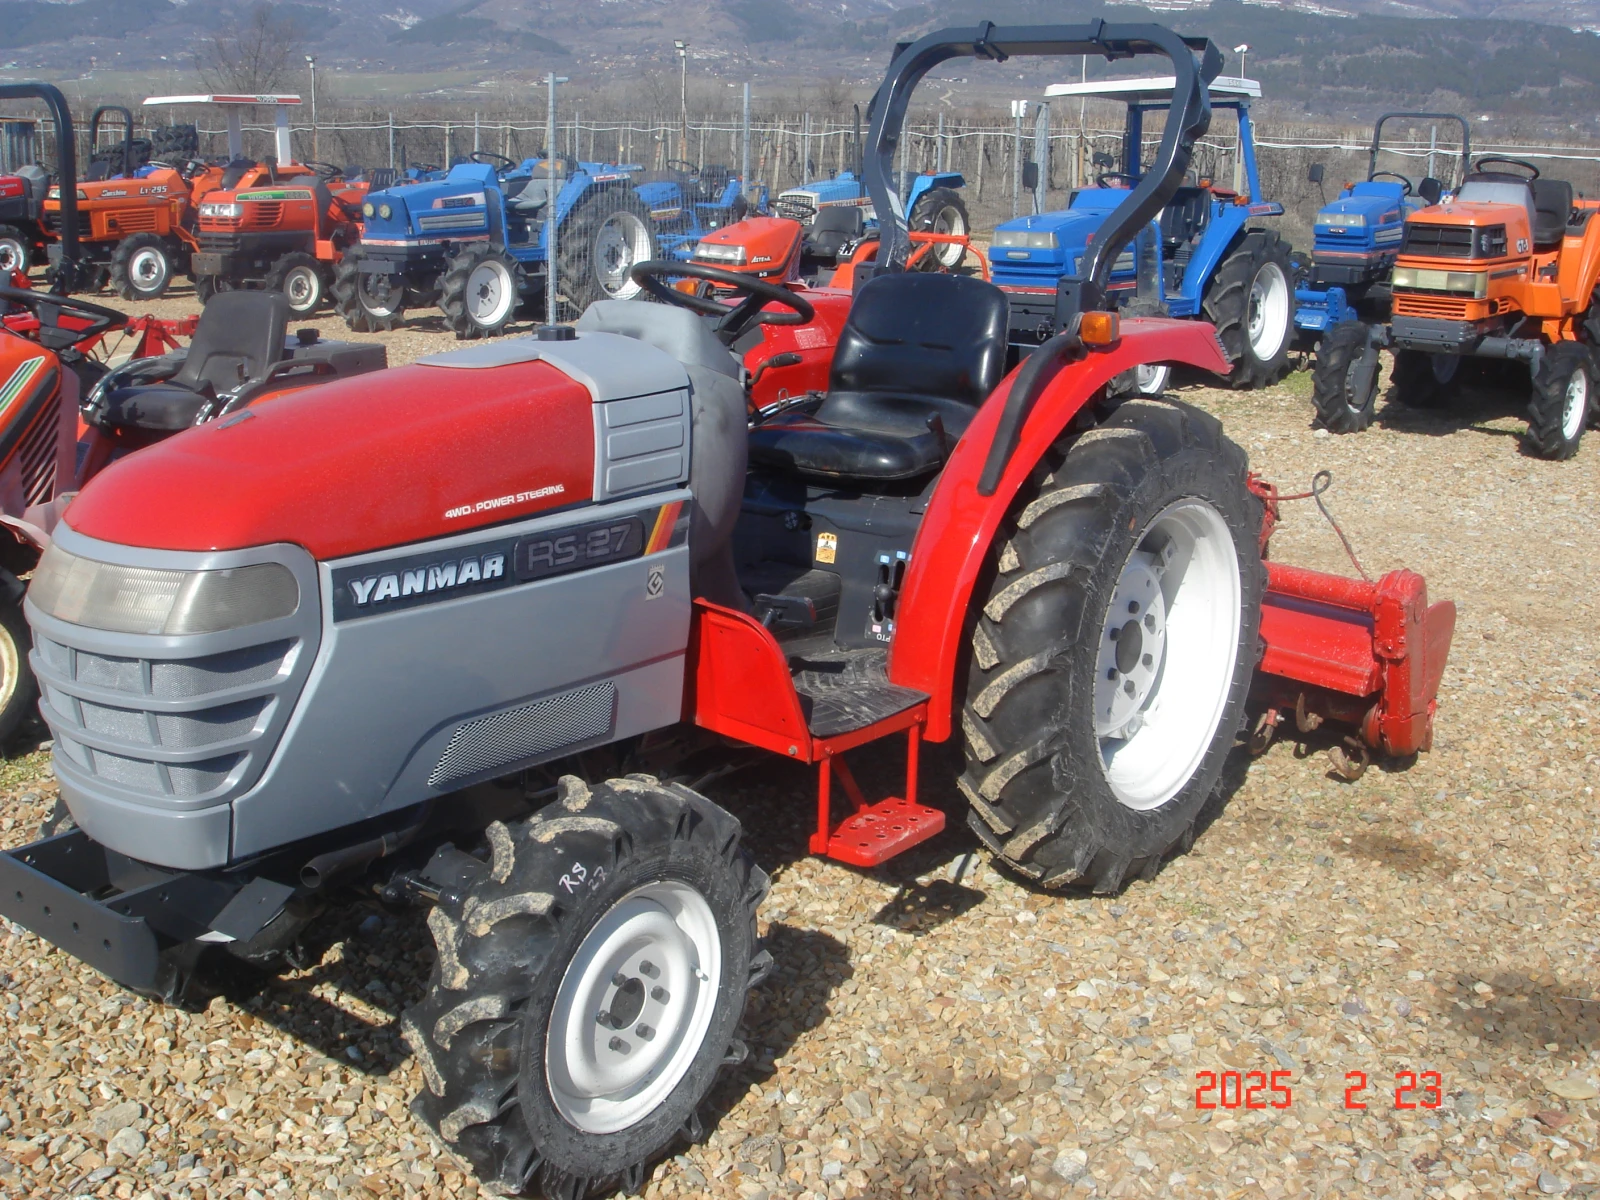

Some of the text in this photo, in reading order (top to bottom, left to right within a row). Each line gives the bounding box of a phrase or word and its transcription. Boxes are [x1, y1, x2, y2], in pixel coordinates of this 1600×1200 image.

[476, 495, 515, 512] POWER
[516, 484, 565, 503] STEERING
[350, 554, 505, 604] YANMAR
[876, 633, 891, 642] PTO
[558, 862, 587, 894] RS
